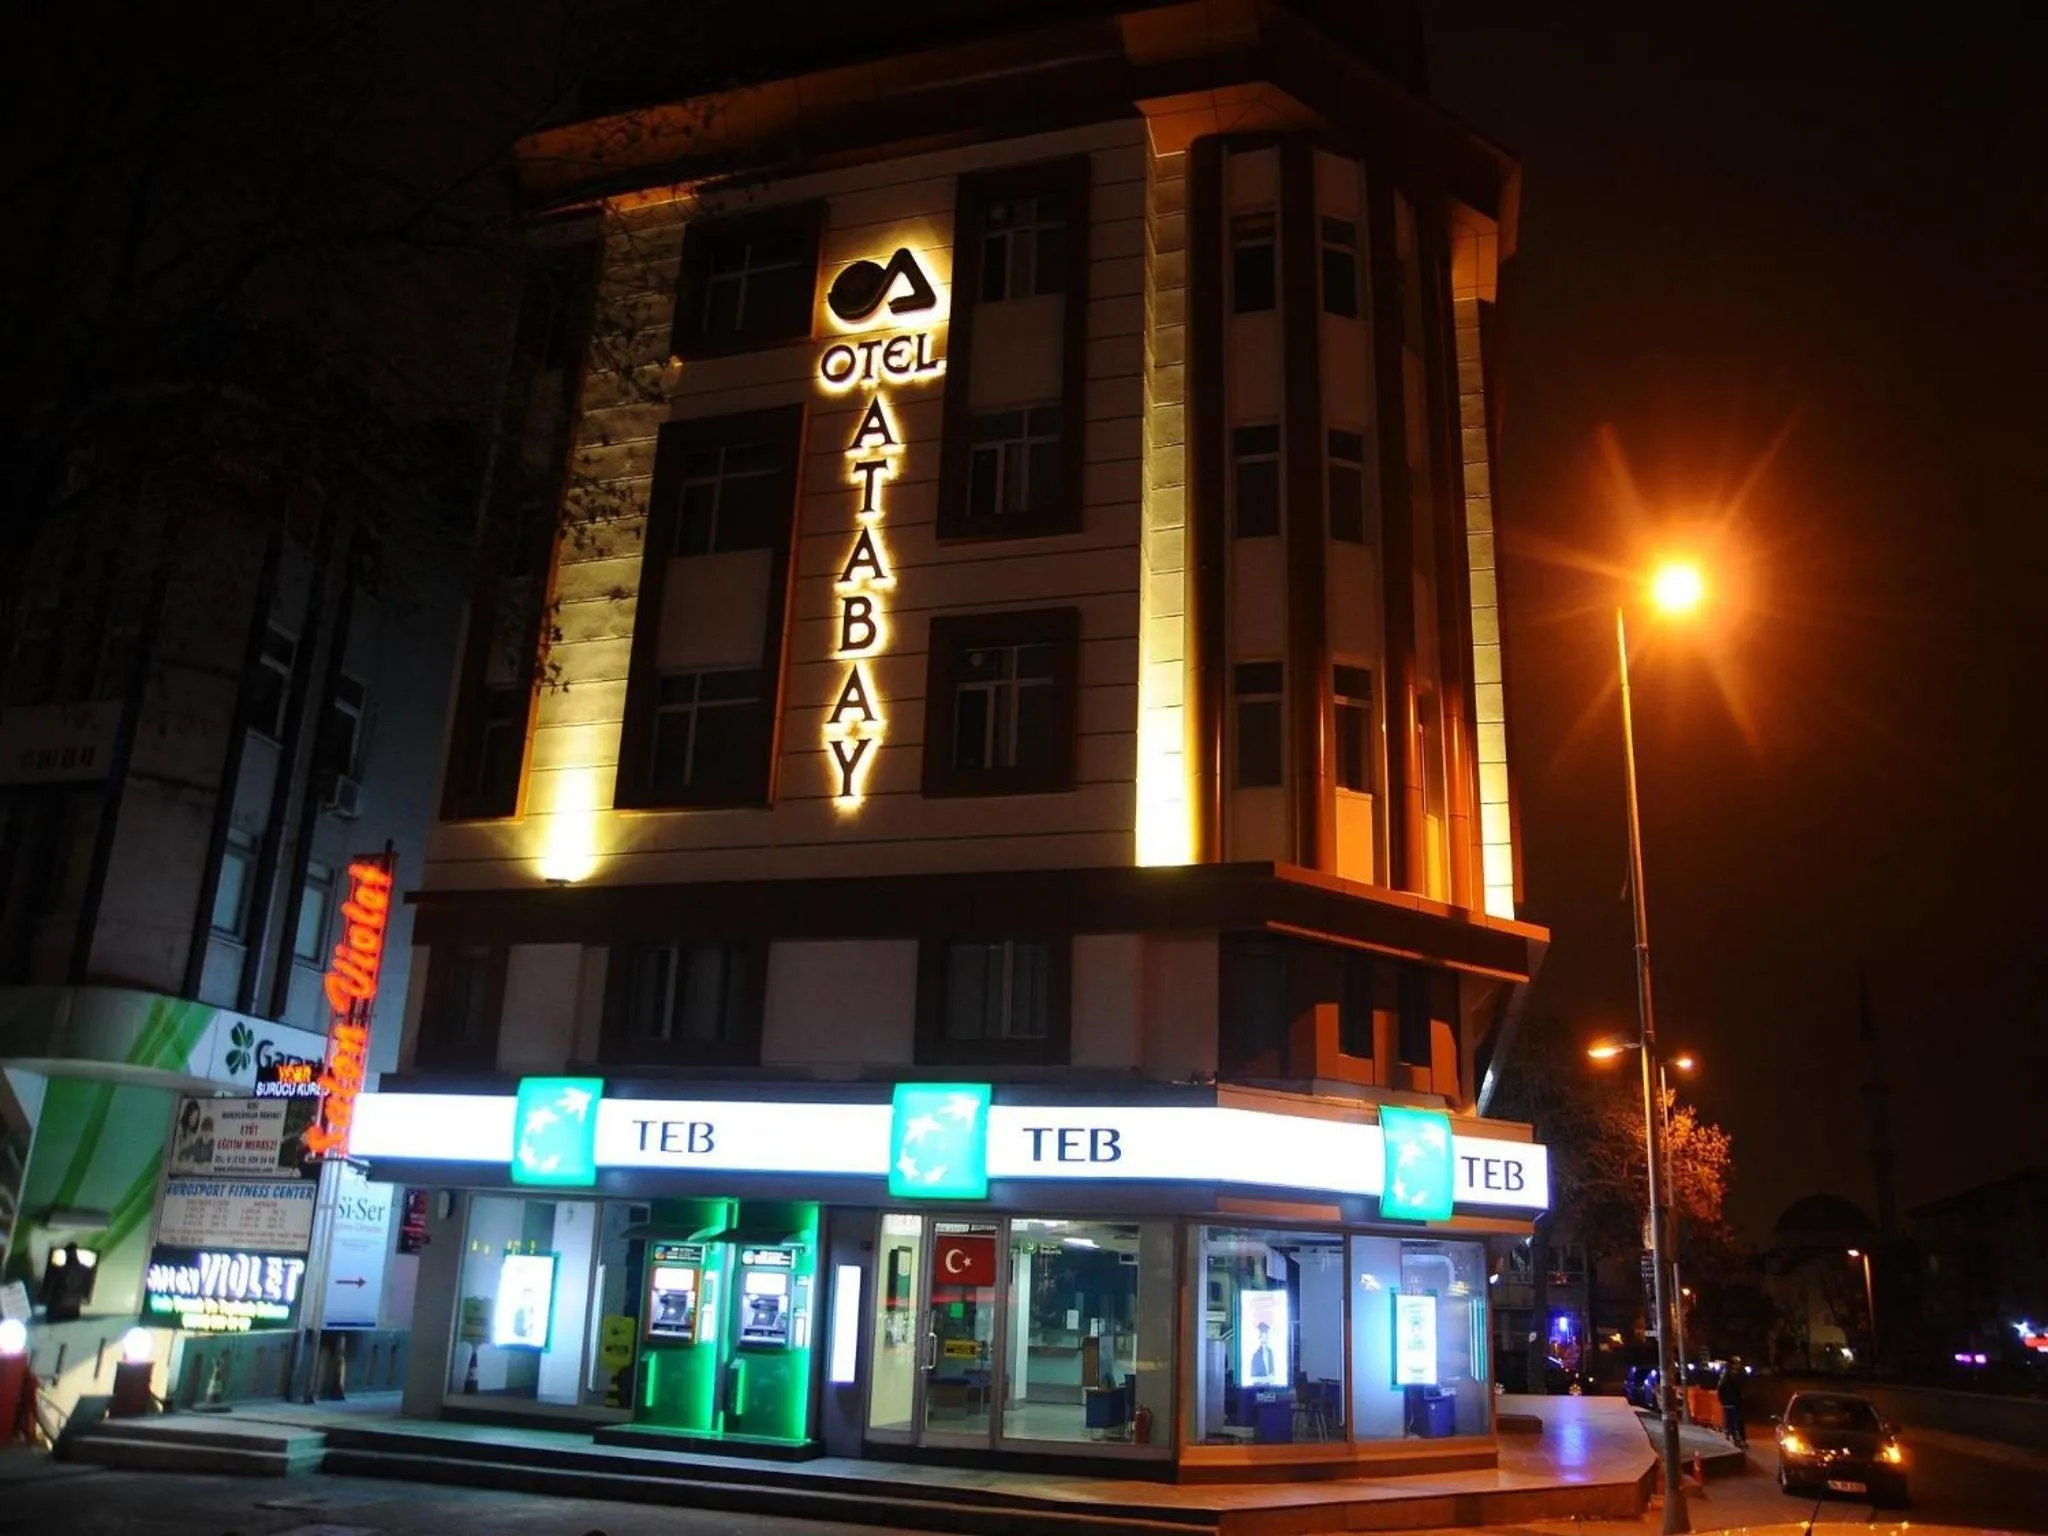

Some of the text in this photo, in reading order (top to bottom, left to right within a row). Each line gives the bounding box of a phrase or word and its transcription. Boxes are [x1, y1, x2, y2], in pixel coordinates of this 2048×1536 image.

[821, 333, 938, 382] OTEL
[828, 394, 898, 797] ATABAY
[325, 863, 393, 1013] Violet
[632, 1120, 715, 1153] TEB
[1022, 1127, 1122, 1162] TEB
[167, 1182, 314, 1200] EUROSPORT FITNESS CENTER
[1460, 1156, 1524, 1191] TEB
[199, 1252, 305, 1301] VIOLET
